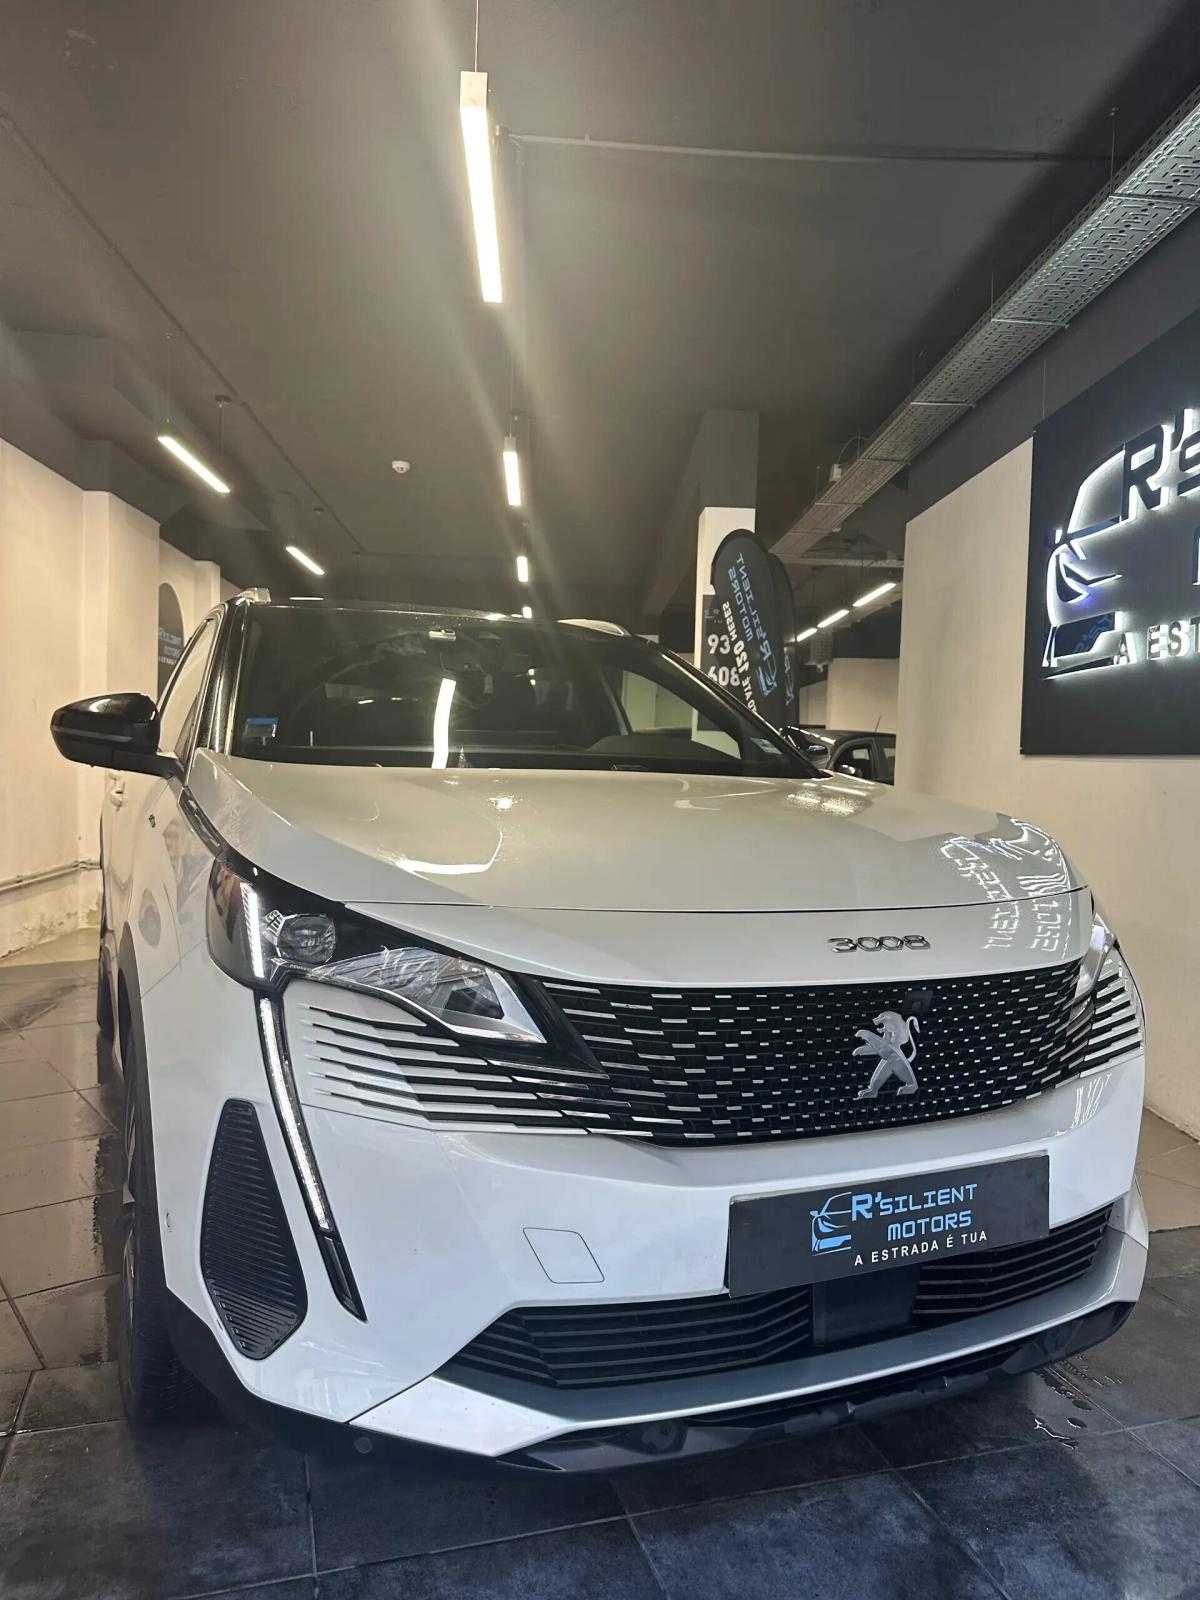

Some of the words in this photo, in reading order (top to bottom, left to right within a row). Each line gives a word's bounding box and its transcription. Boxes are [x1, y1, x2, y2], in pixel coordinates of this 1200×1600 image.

[1115, 632, 1131, 665] A
[827, 935, 930, 953] 3008
[852, 1183, 977, 1221] R'SILIENT
[888, 1210, 972, 1241] MOTORS
[854, 1253, 863, 1266] A
[871, 1240, 939, 1263] ESTRADA
[946, 1233, 953, 1248] É
[961, 1230, 987, 1245] TUA
